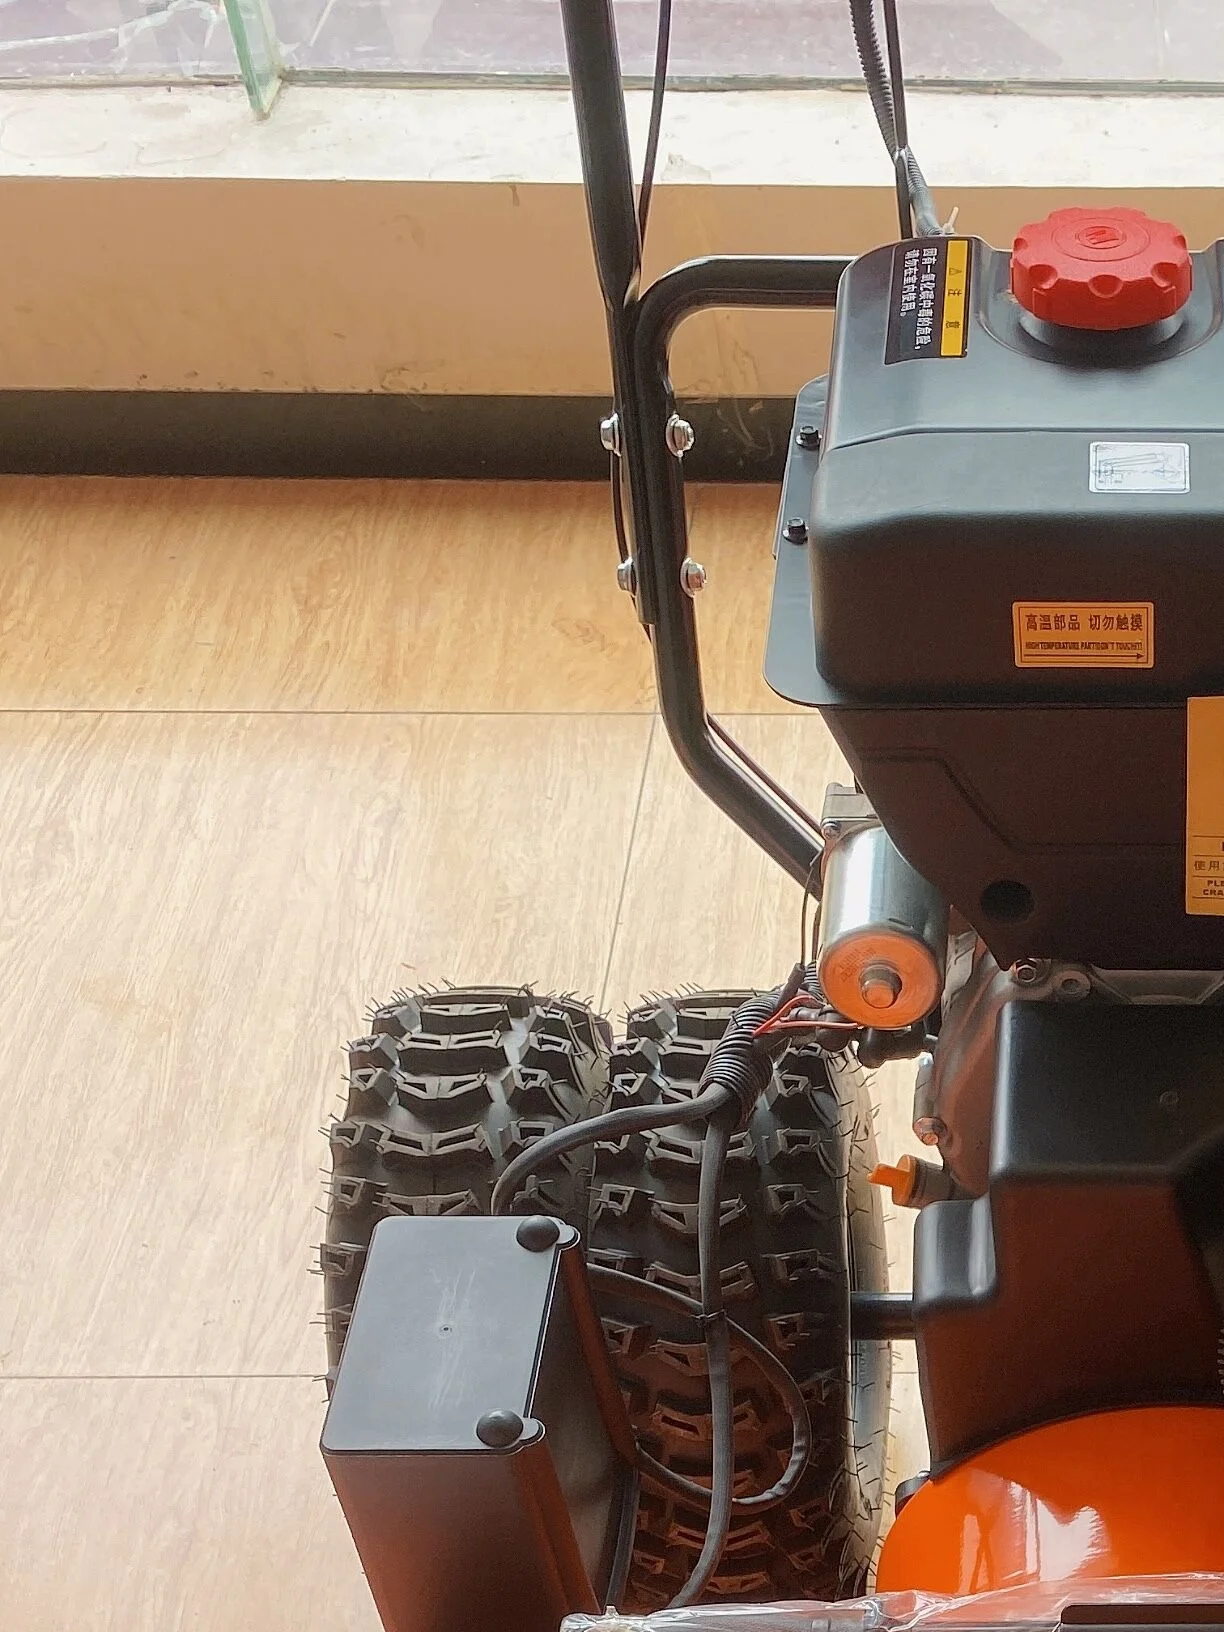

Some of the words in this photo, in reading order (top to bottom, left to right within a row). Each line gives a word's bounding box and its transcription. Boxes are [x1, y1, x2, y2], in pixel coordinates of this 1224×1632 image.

[1025, 613, 1081, 632] 高温部品
[1088, 613, 1144, 632] 切勿触摸
